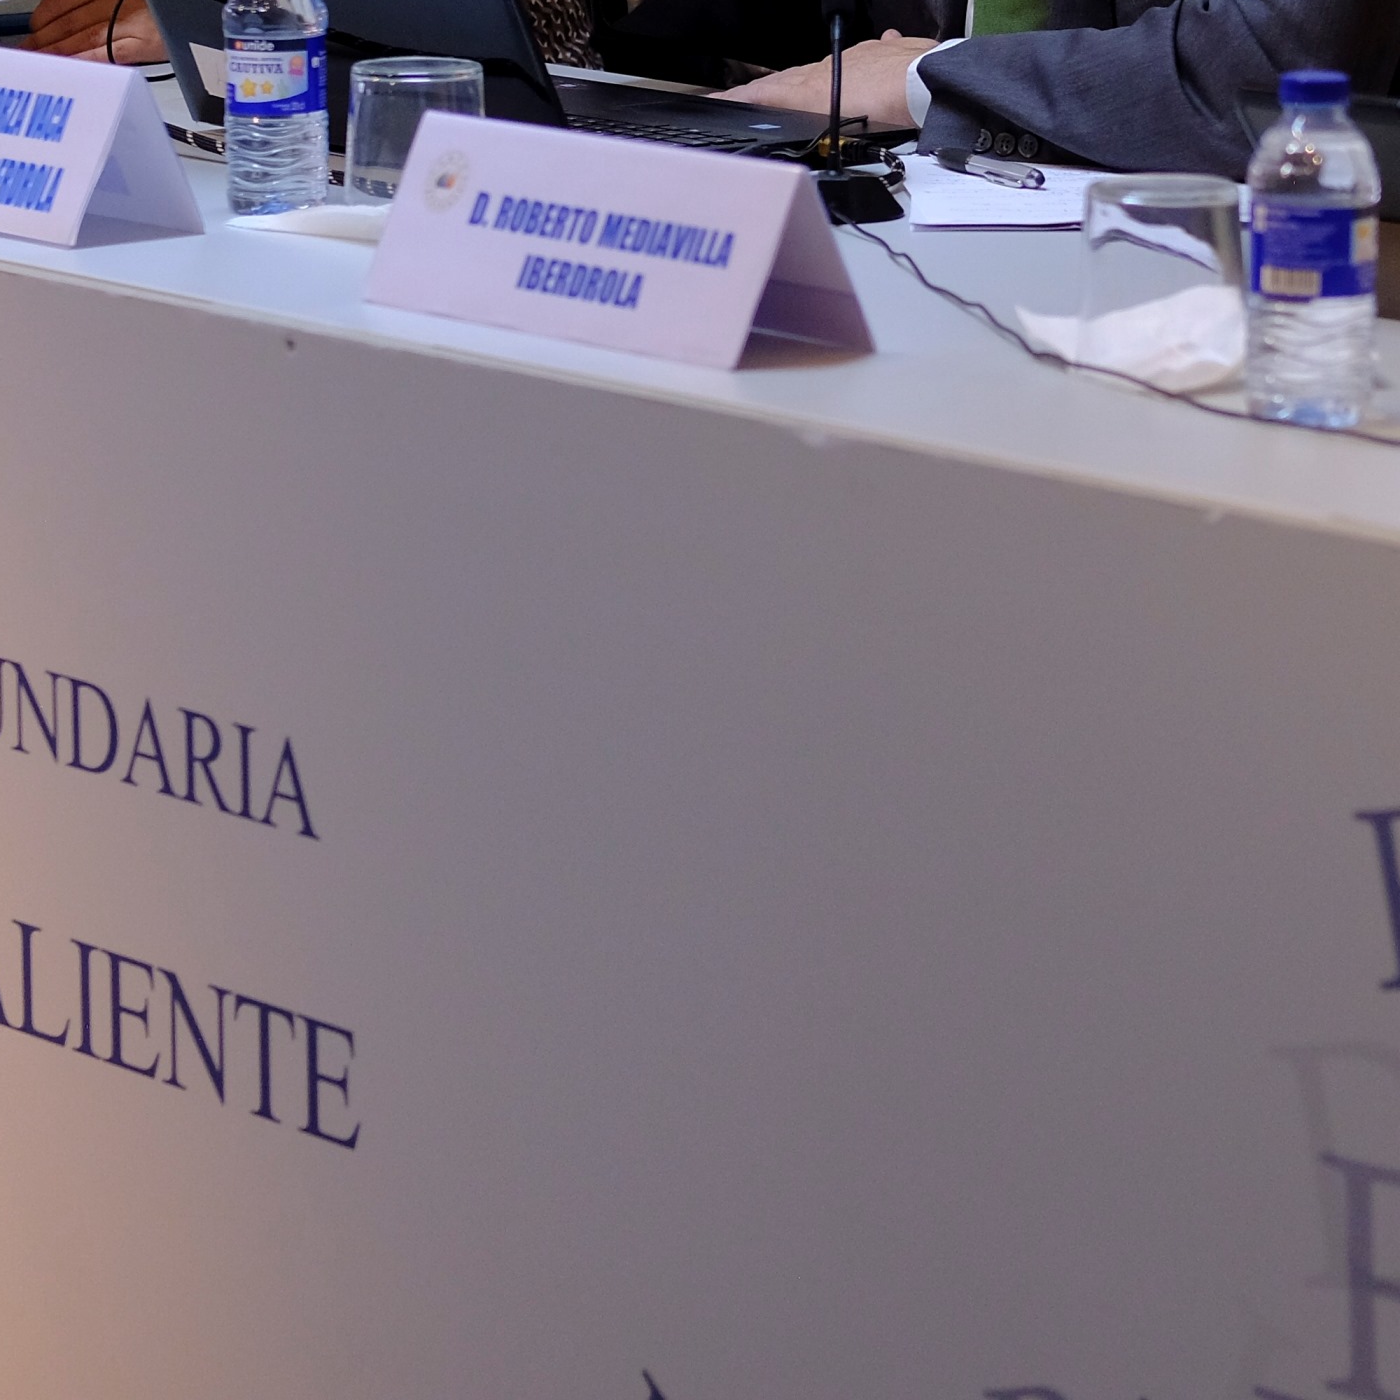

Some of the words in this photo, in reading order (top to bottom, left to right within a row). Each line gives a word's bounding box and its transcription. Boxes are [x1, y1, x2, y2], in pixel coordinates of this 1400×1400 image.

[467, 190, 491, 228] D.
[492, 194, 599, 246] ROBERTO
[596, 211, 736, 269] MEDIAVILLA
[515, 253, 644, 310] IBERDROLA
